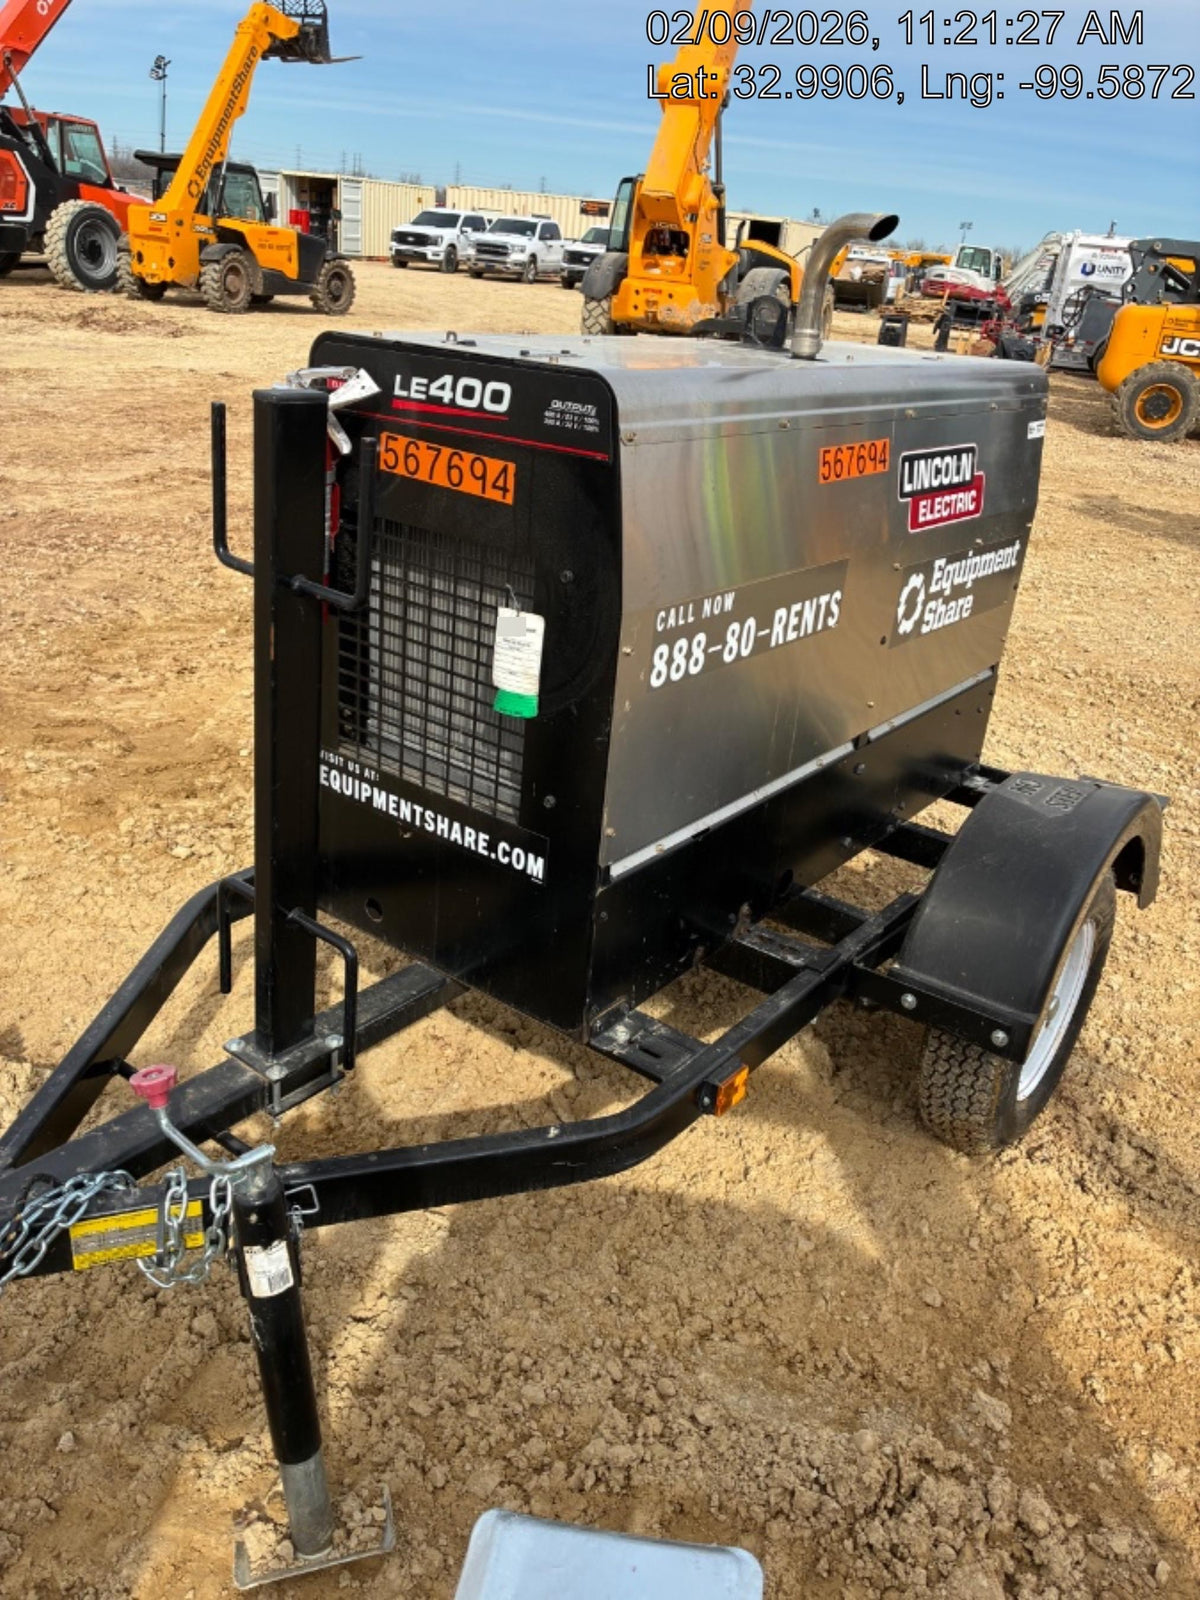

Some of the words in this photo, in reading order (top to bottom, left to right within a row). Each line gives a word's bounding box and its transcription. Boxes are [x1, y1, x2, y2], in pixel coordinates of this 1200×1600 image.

[195, 45, 258, 181] EquipmentShare
[393, 374, 512, 413] LE400
[383, 435, 510, 500] 567694
[821, 441, 888, 481] 567694
[903, 452, 972, 493] LINCOLN
[918, 489, 976, 523] ELECTRIC
[929, 539, 1021, 596] Equipment
[656, 603, 695, 632] CALL
[702, 591, 736, 619] NOW
[921, 594, 974, 634] Share
[650, 589, 842, 688] 888-80-RENTS
[347, 760, 360, 774] US
[319, 763, 545, 880] EQUIPMENTSHARE.COM
